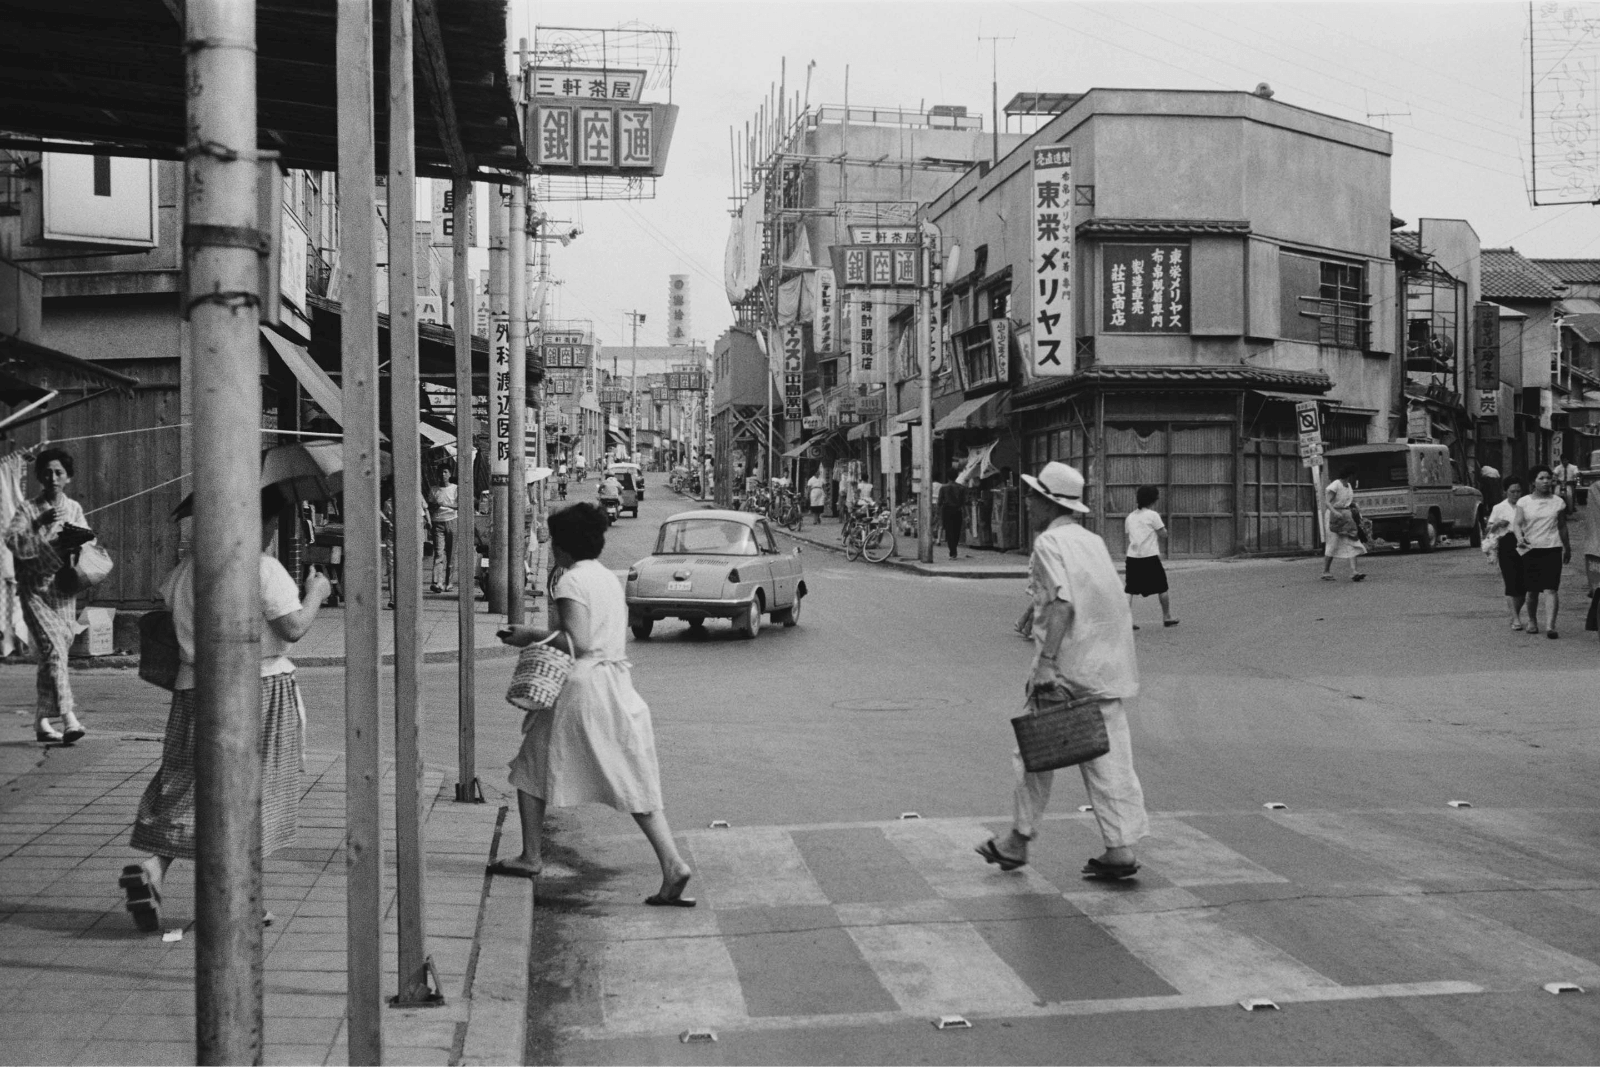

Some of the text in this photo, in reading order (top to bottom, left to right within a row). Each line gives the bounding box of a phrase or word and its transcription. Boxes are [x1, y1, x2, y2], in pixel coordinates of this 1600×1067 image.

[537, 77, 631, 98] 三軒茶屋
[543, 110, 649, 161] 銀座通
[860, 231, 918, 244] 三軒茶屋
[848, 251, 915, 282] 銀座通
[1037, 180, 1061, 366] 東栄メリヤス
[1131, 258, 1145, 315] 製造直売
[1151, 247, 1165, 328] 布帛肌着専門
[1169, 247, 1183, 328] 東栄メリヤス
[785, 337, 801, 371] クスリ
